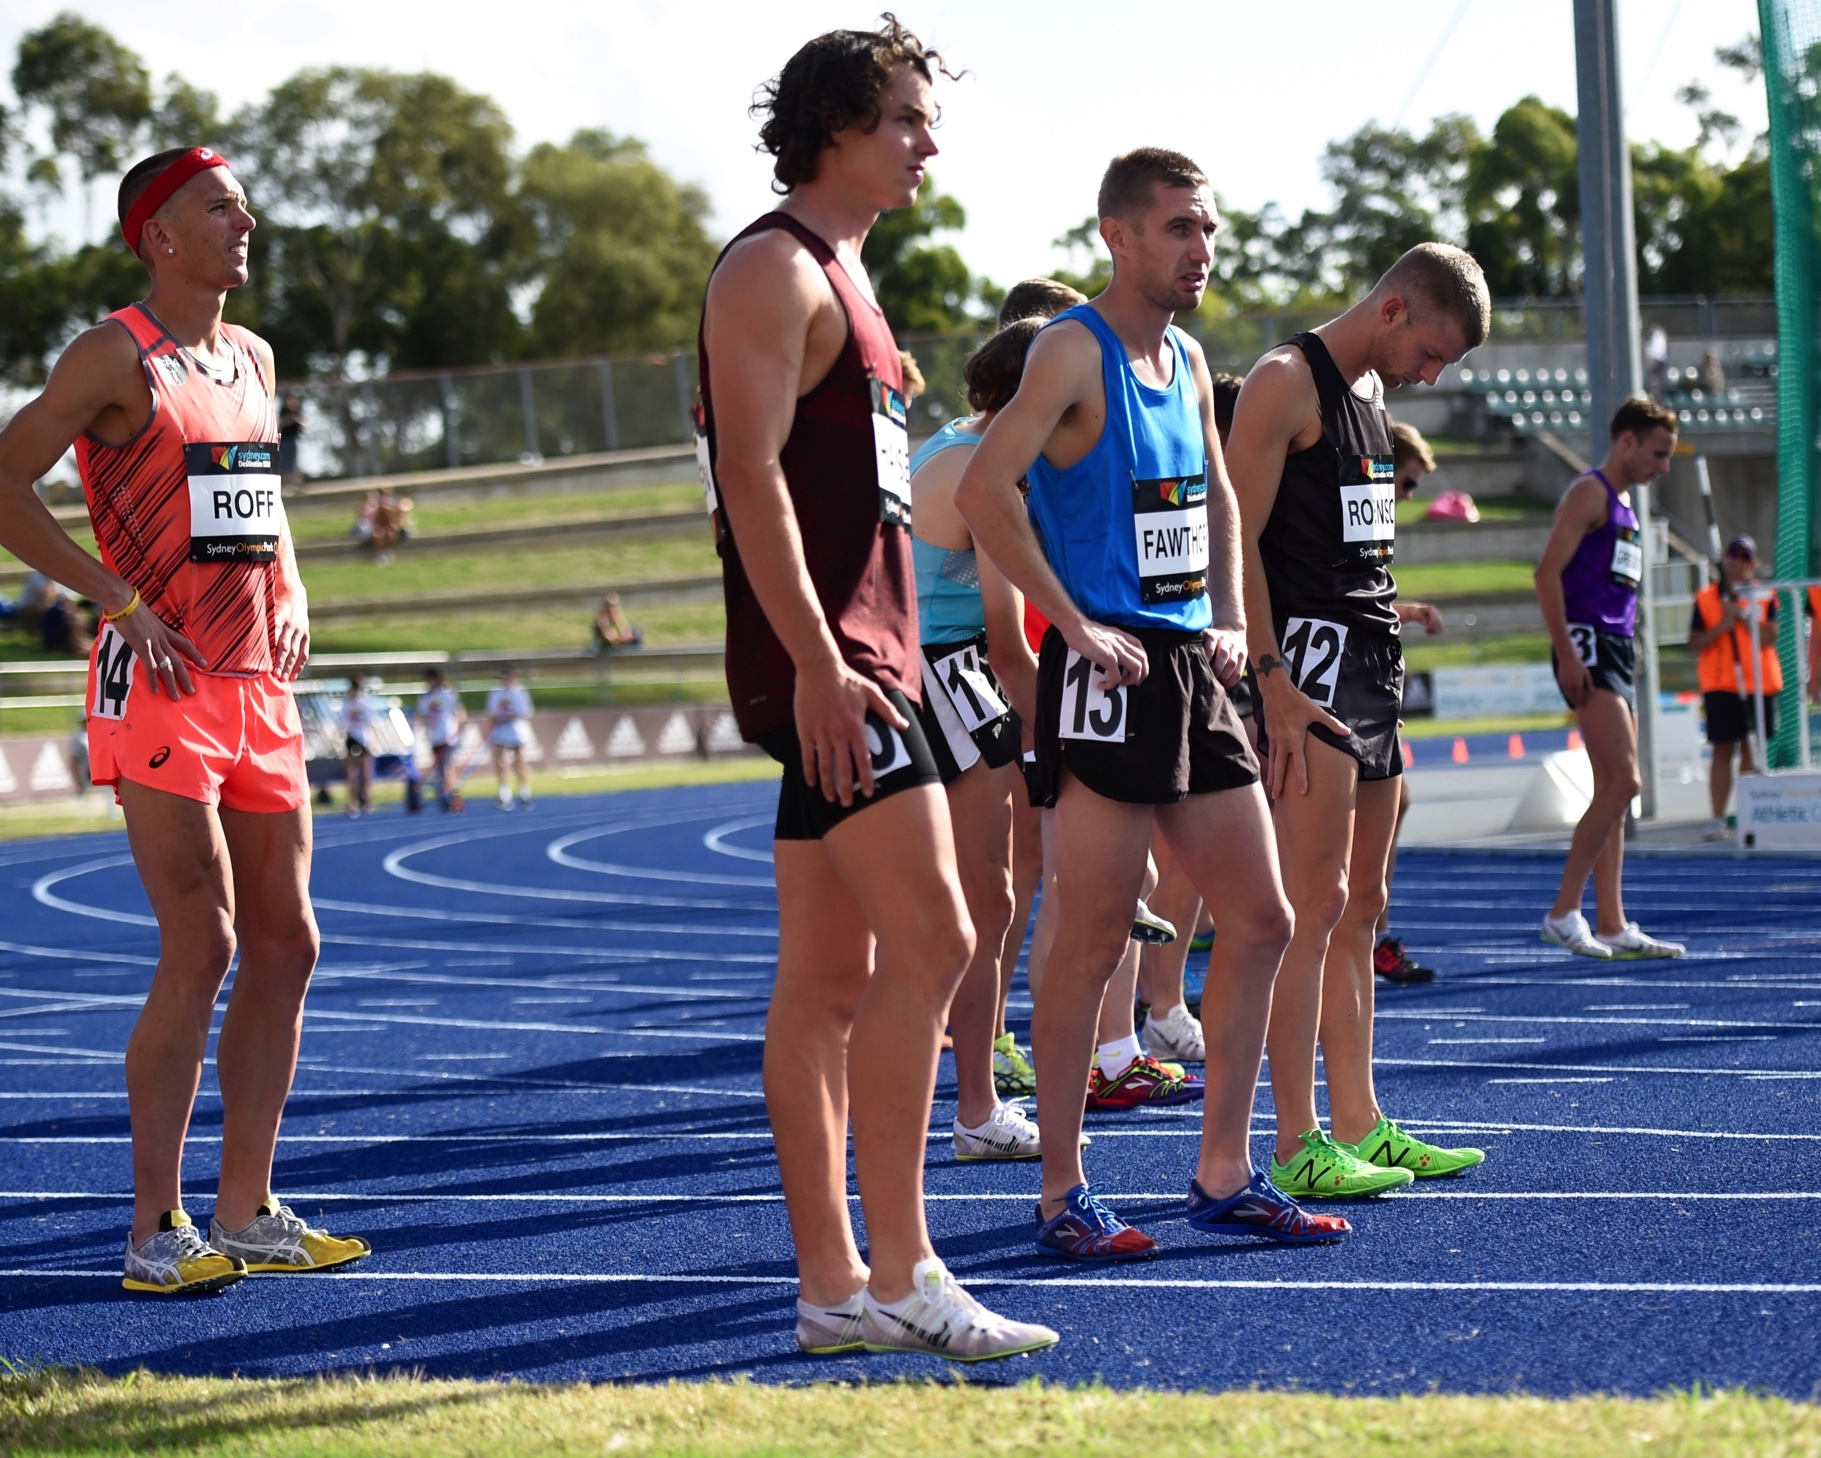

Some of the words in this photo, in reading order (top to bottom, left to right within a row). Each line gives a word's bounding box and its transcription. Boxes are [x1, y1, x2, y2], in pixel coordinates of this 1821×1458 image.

[213, 489, 274, 519] ROFF
[97, 630, 133, 716] 14
[1066, 655, 1124, 737] 13
[1283, 620, 1340, 703] 12
